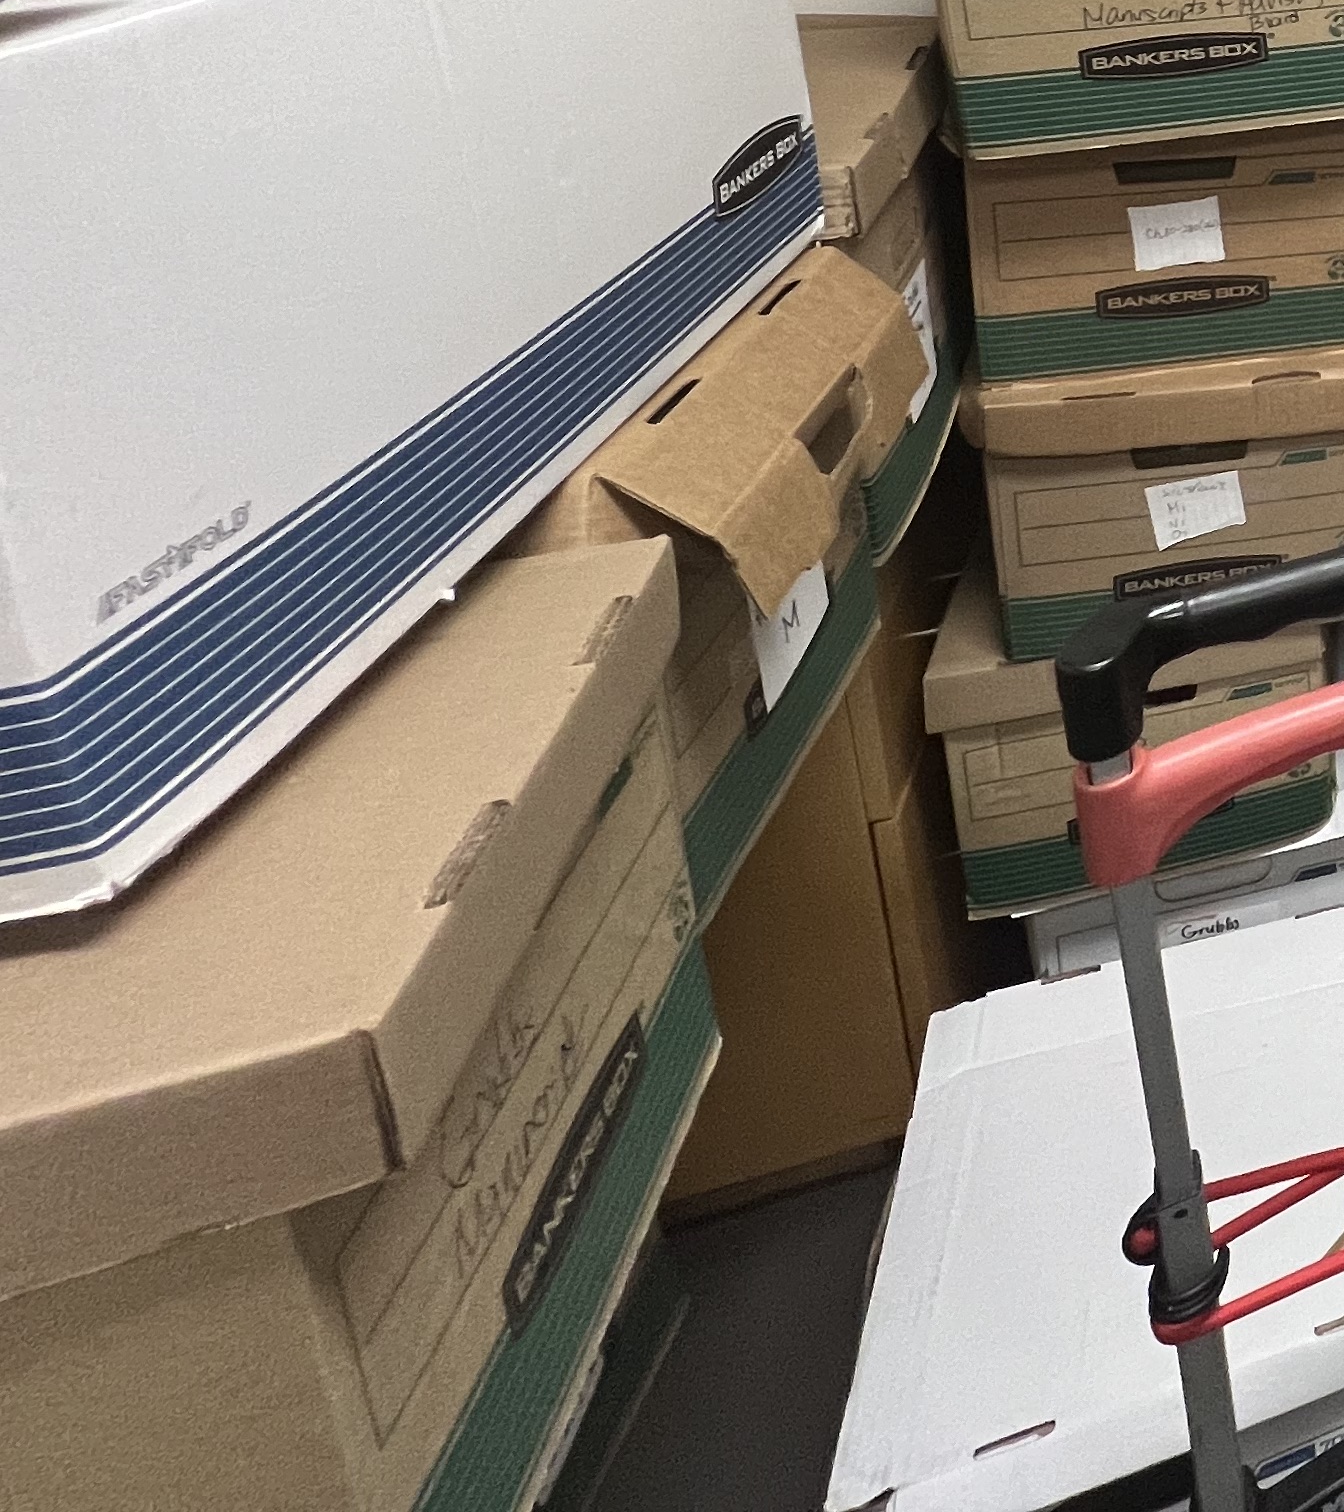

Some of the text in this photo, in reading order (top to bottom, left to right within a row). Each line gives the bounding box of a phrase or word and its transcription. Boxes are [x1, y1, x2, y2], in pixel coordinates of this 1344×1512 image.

[1092, 40, 1259, 70] BANKERS BOX
[720, 131, 799, 204] BANKERS BOX
[1107, 284, 1261, 310] BANKERS BOX
[1124, 563, 1274, 593] BANKERS BOX
[1181, 916, 1240, 939] Grubbs
